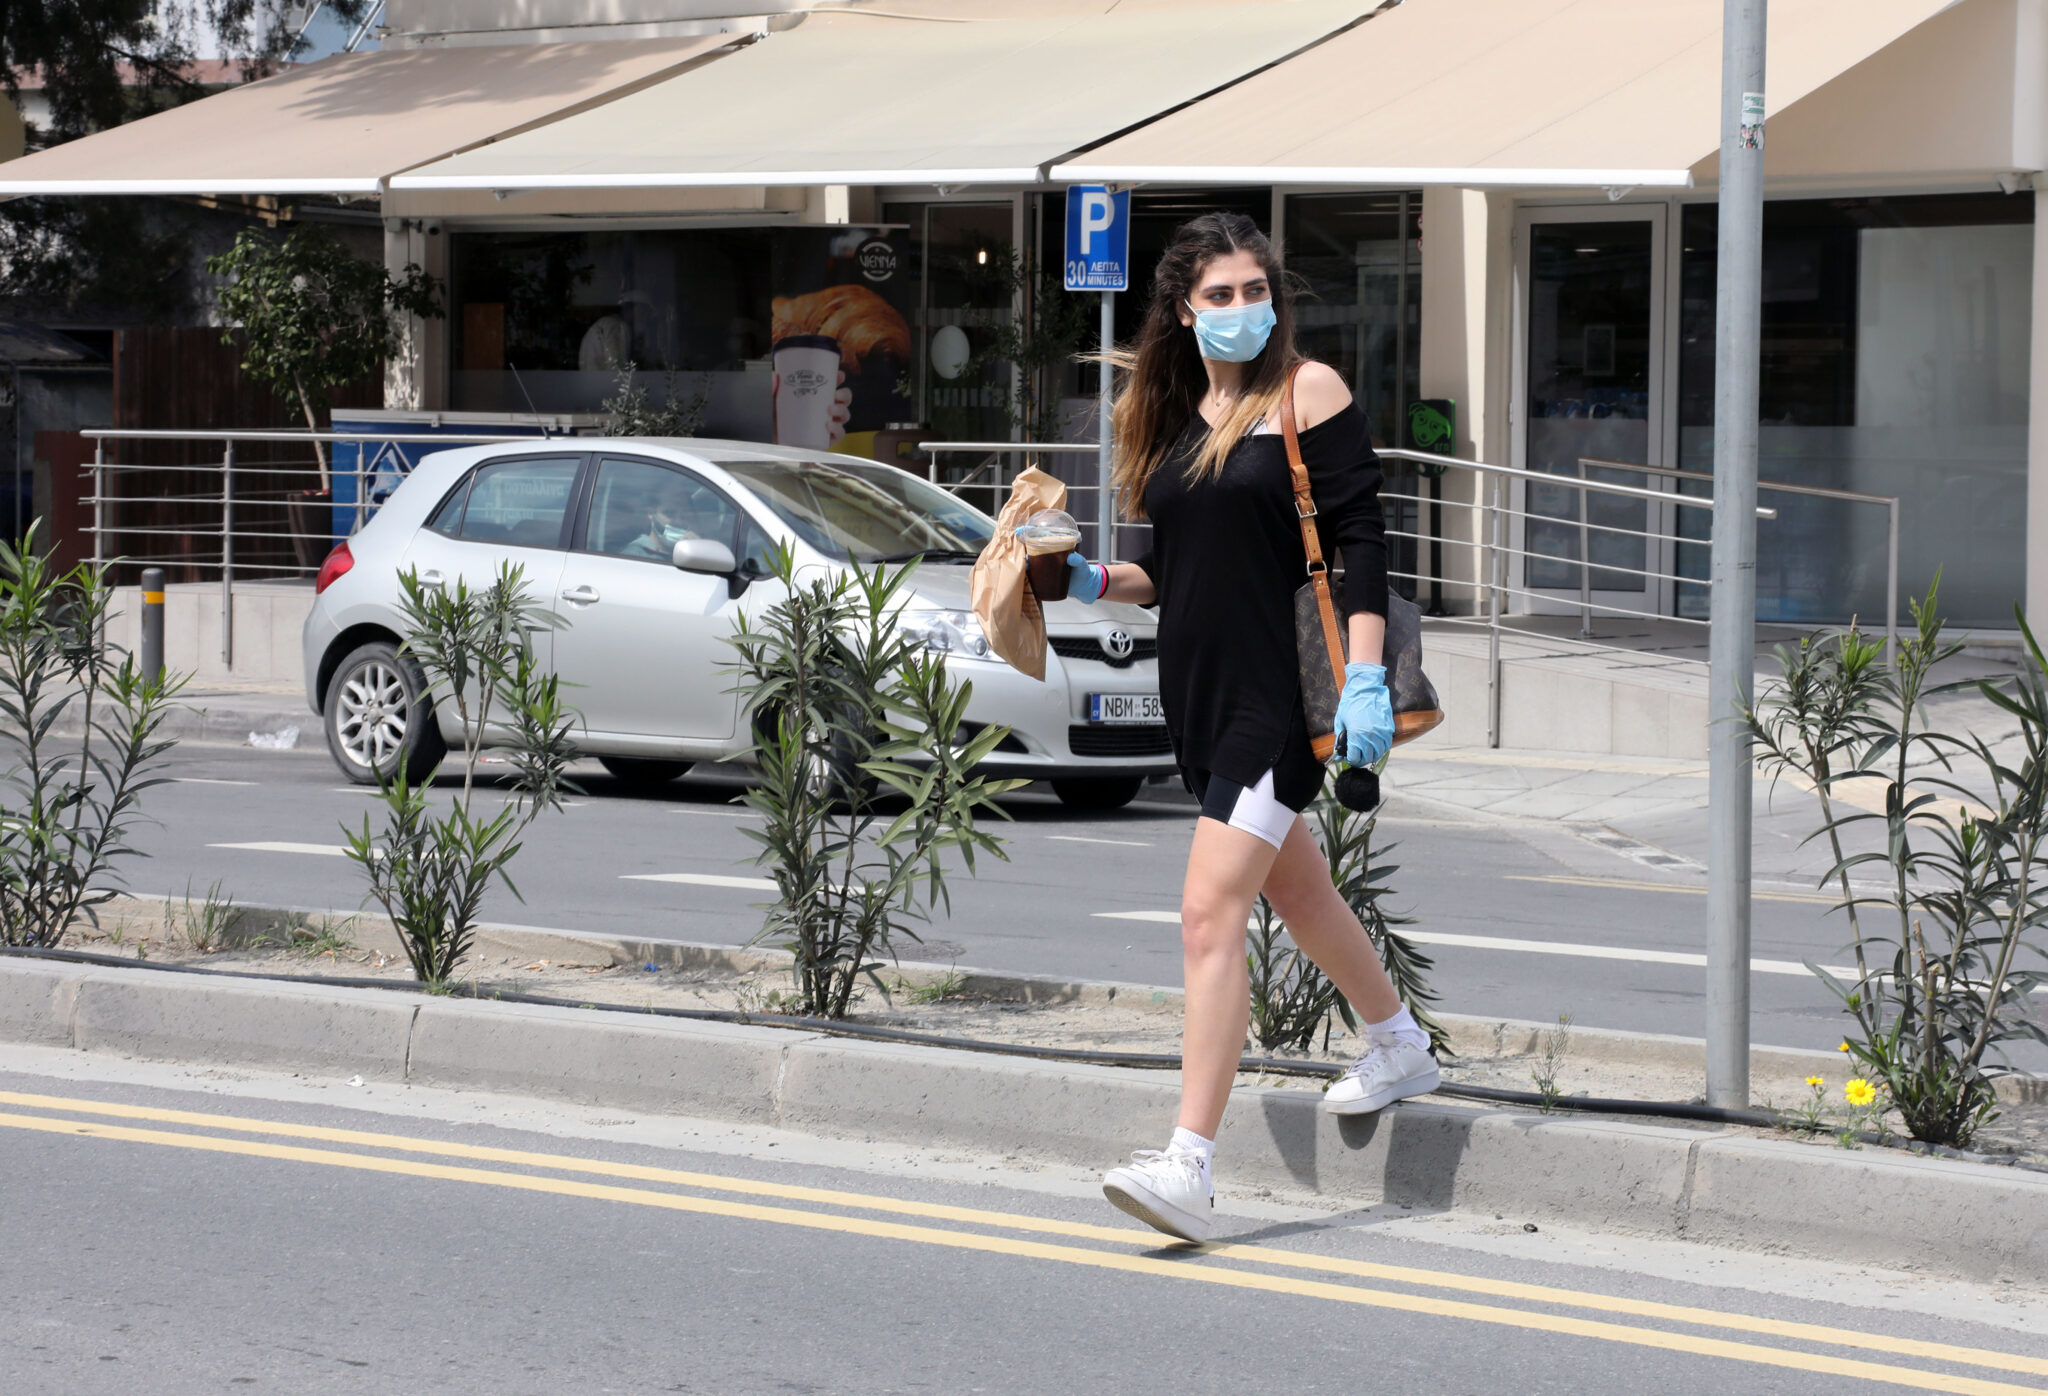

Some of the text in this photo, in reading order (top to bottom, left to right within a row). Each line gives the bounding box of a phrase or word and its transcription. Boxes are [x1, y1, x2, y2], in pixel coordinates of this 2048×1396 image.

[1081, 192, 1115, 255] P
[859, 255, 897, 269] VIENNA
[1091, 262, 1120, 272] ΛΕΠΤΑ
[1068, 261, 1086, 286] 30
[1088, 276, 1123, 286] MINUTES
[1105, 697, 1133, 718] NBM
